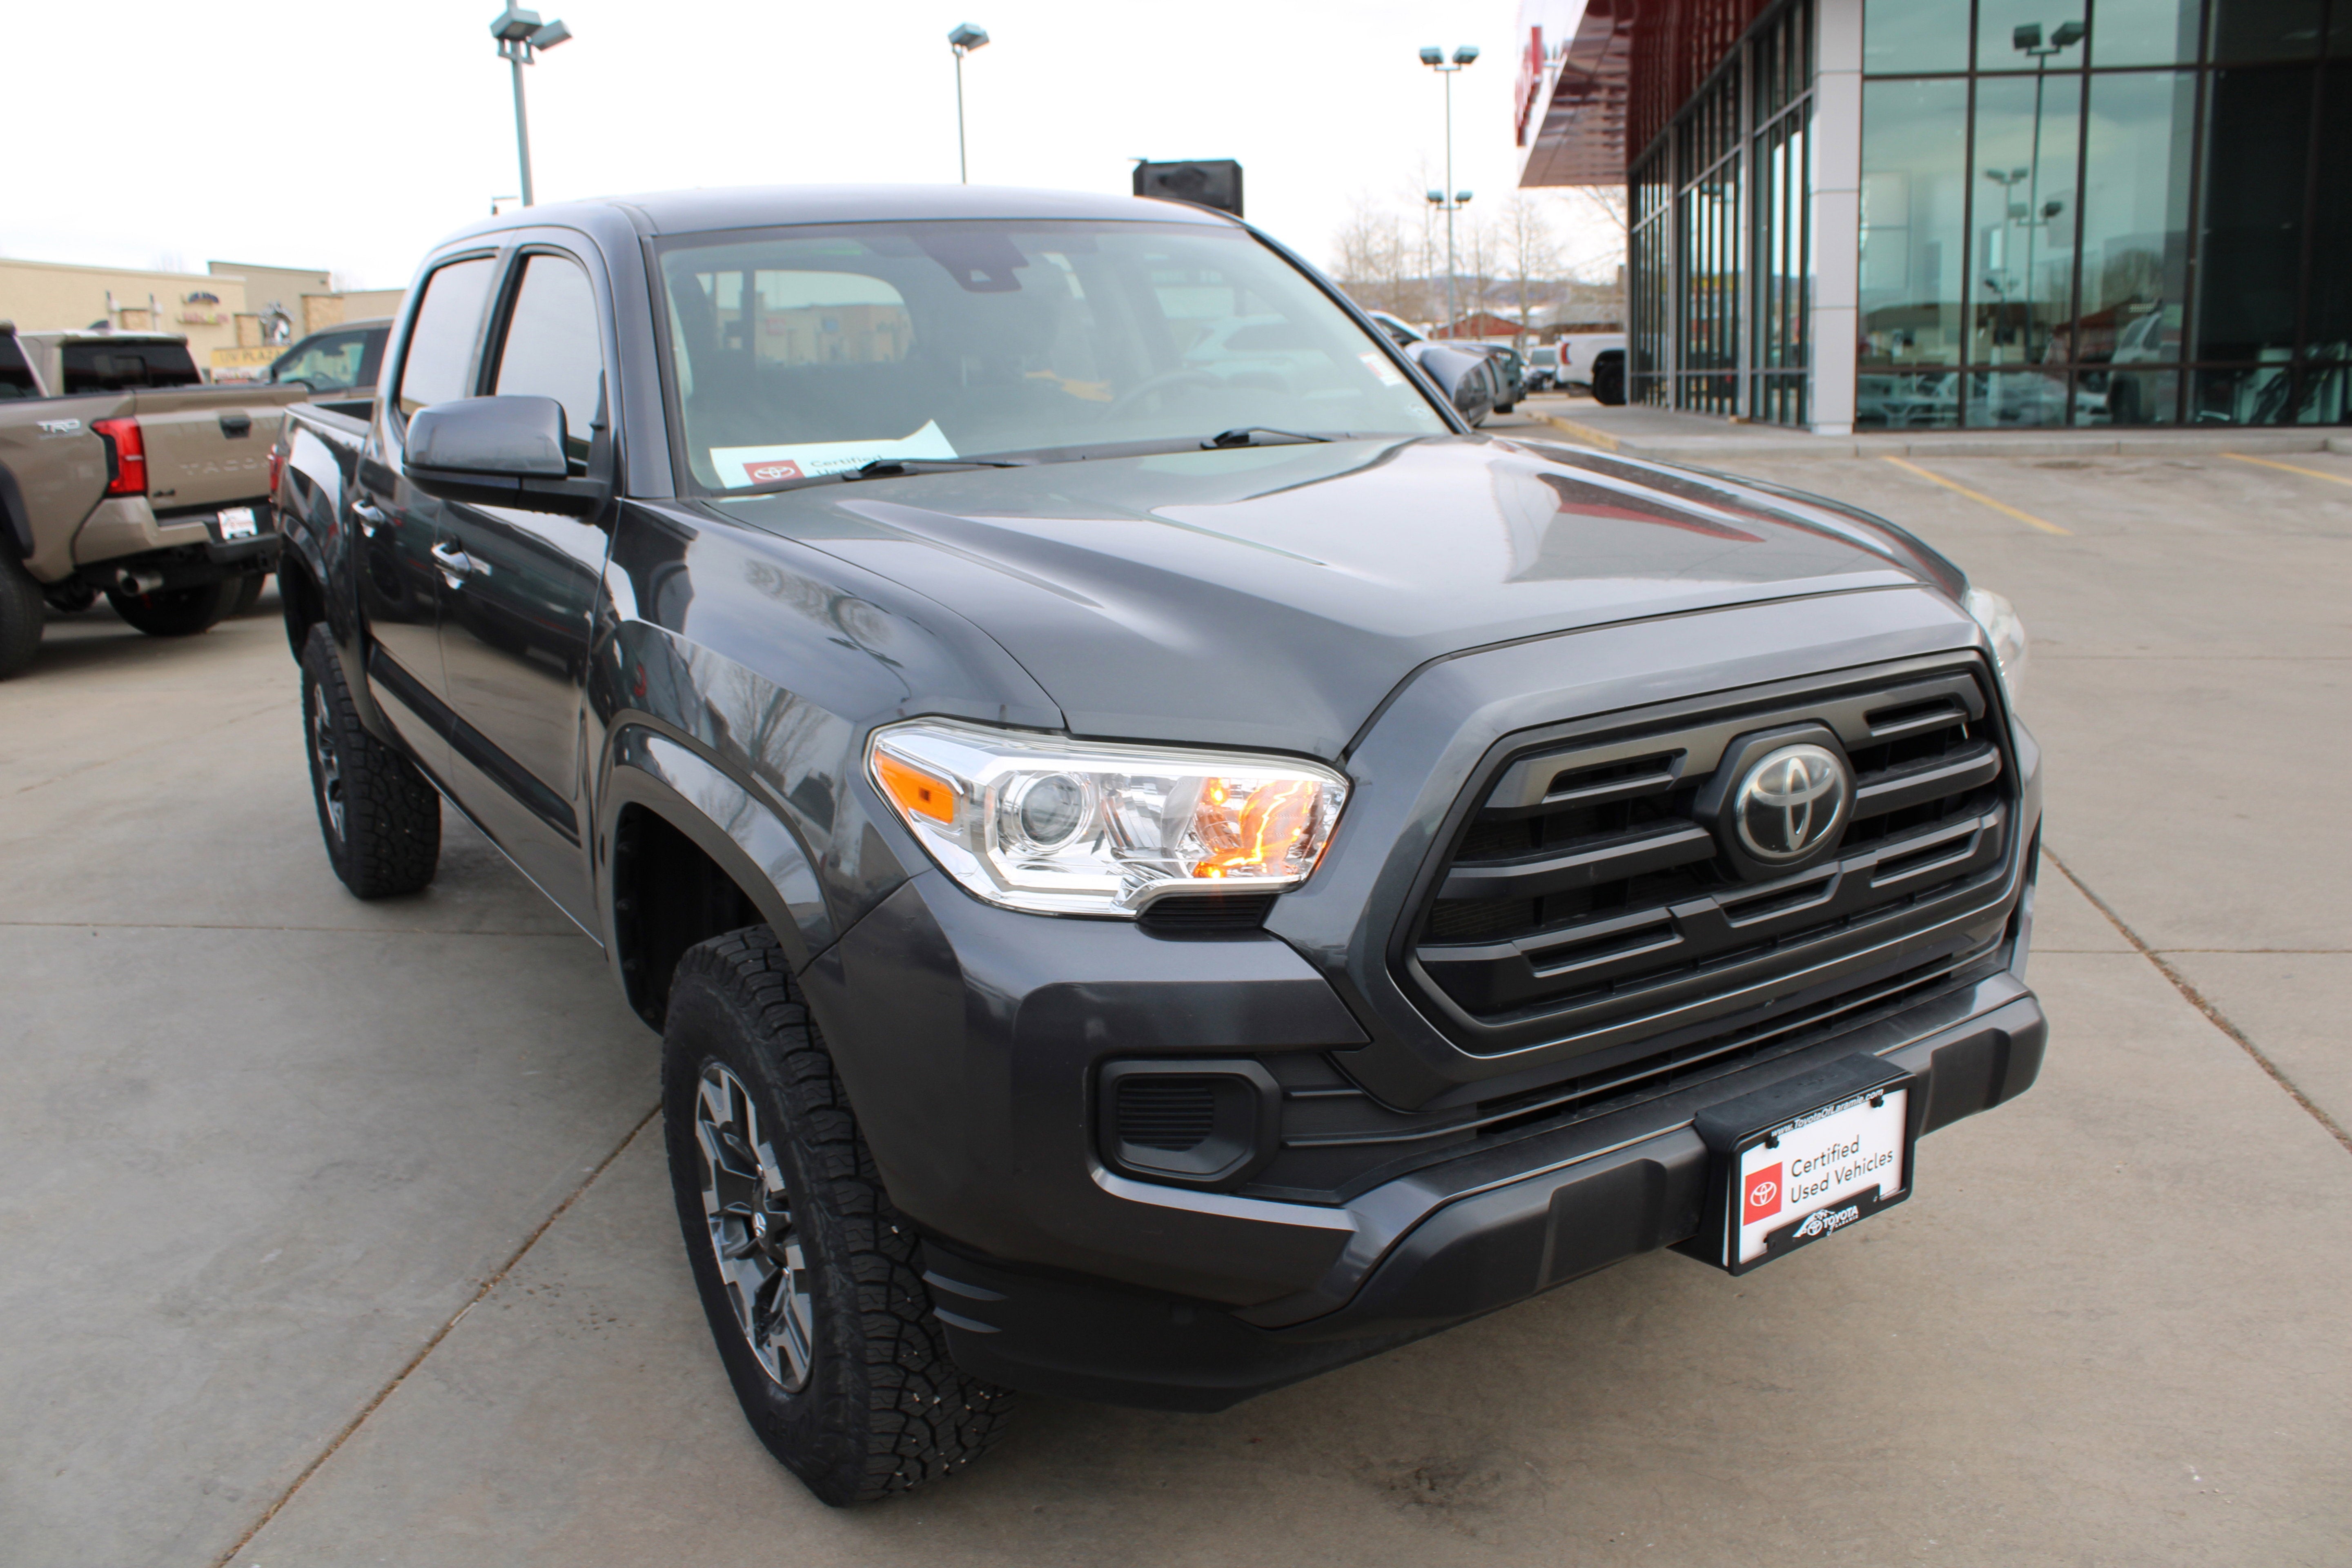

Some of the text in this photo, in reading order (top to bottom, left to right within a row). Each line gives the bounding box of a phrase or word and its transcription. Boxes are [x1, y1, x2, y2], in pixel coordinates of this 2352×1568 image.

[36, 419, 81, 433] TRD
[1791, 1134, 1860, 1177] Certified
[1791, 1150, 1893, 1203] Used Vehicles
[1822, 1205, 1859, 1228] TOYOTA
